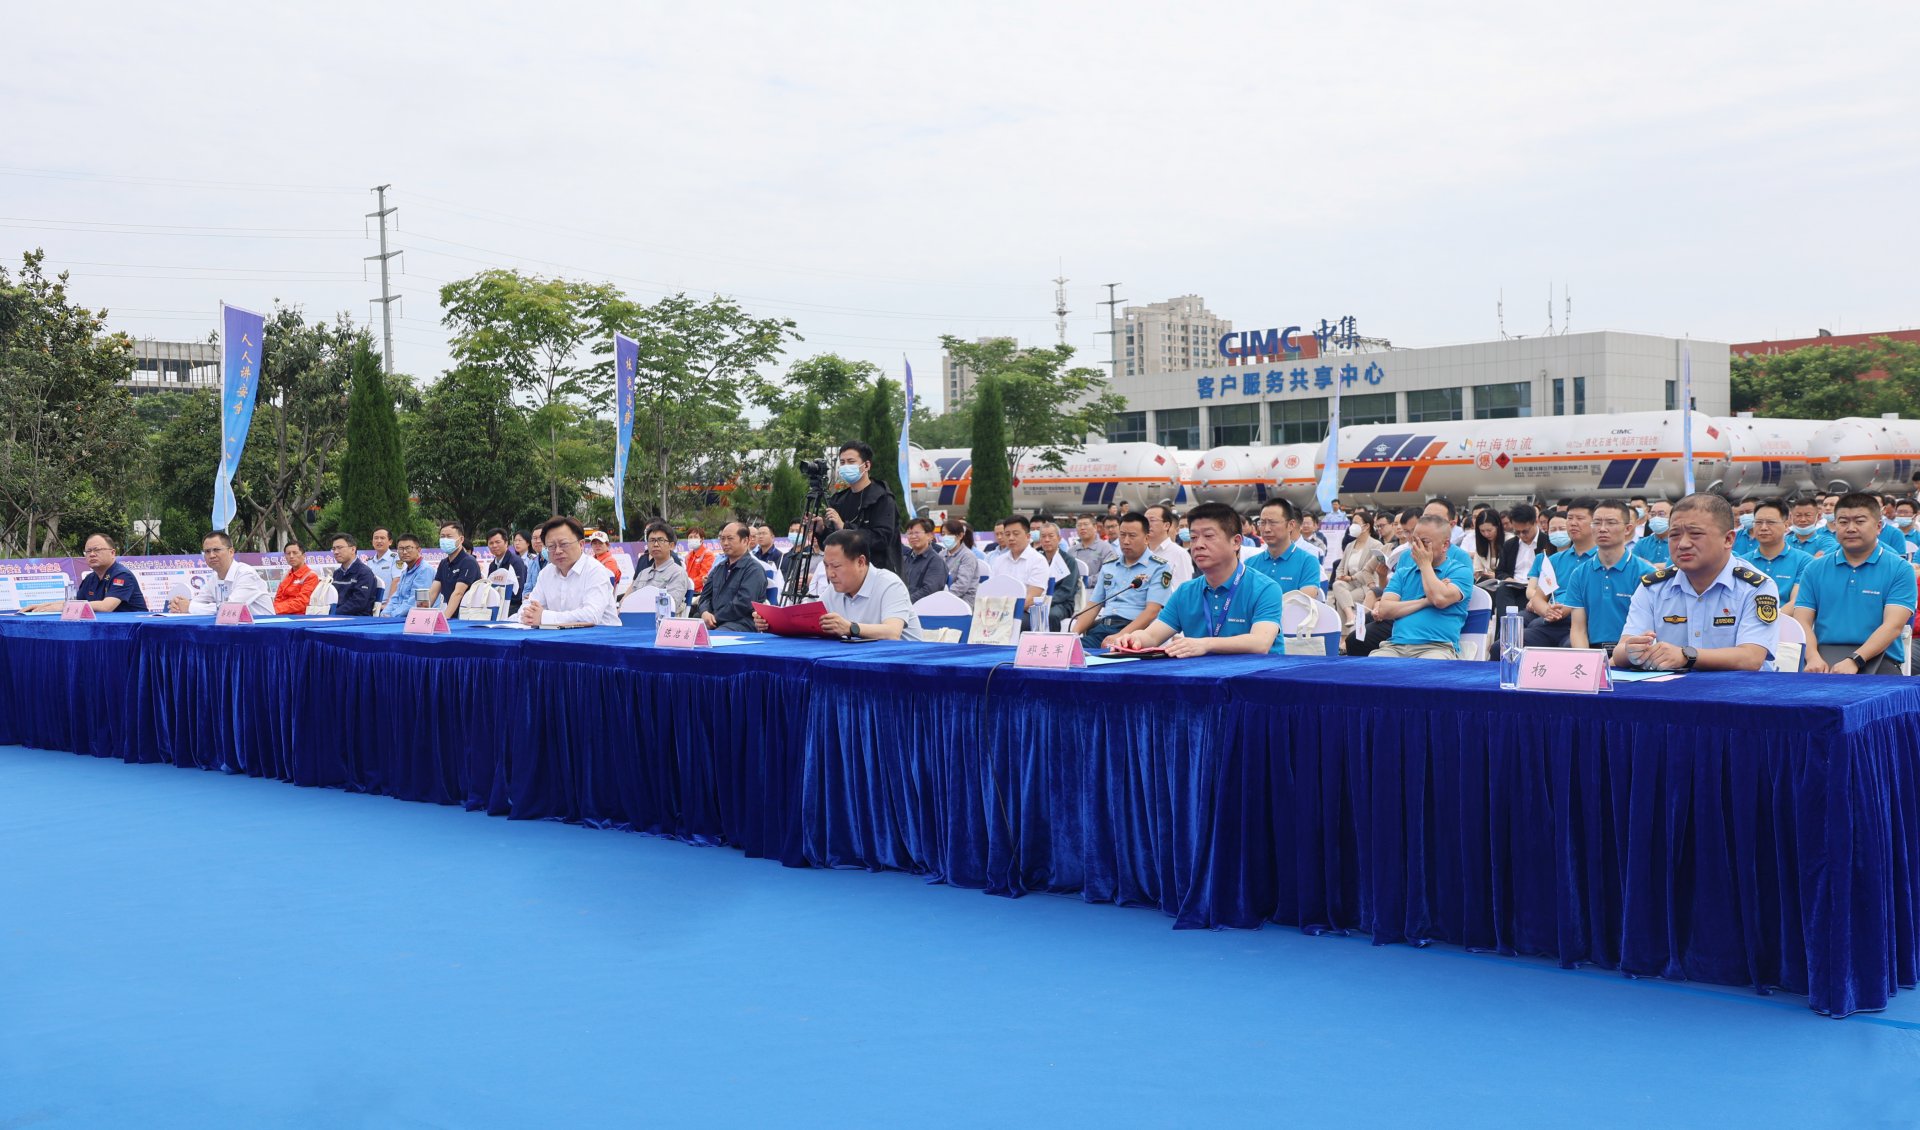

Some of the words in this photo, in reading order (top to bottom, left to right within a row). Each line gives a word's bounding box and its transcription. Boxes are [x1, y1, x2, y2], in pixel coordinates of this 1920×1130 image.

[1219, 326, 1302, 359] CIMC
[1313, 315, 1360, 352] 中集
[233, 333, 254, 415] 人人讲安全
[1198, 361, 1384, 399] 客户服务共享中心
[1476, 436, 1534, 451] 中海物流
[1478, 452, 1491, 468] 爆
[1233, 573, 1241, 585] CIMC
[1223, 598, 1231, 610] CIMC
[1531, 662, 1588, 679] 杨冬
